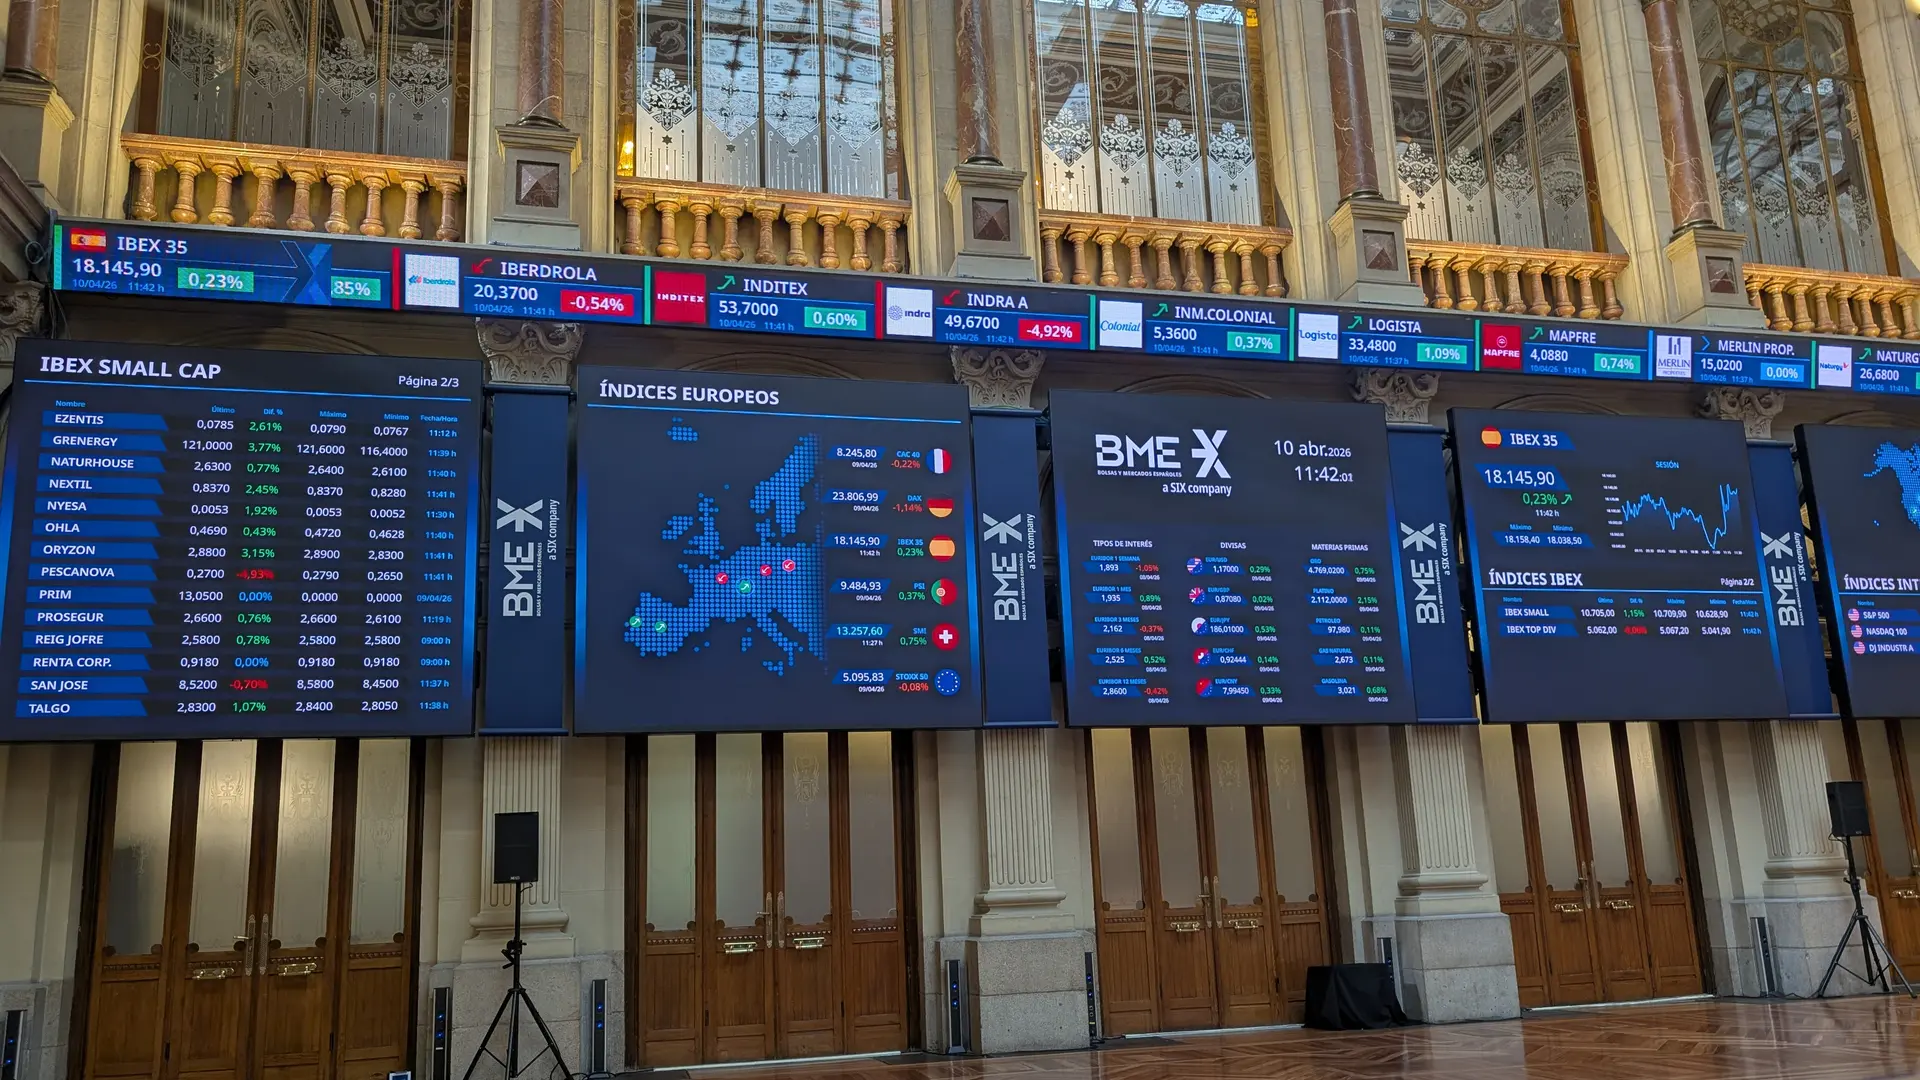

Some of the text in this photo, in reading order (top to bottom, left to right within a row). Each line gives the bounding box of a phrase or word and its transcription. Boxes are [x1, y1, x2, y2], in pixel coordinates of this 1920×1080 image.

[118, 237, 187, 254] IBEX 35
[73, 259, 243, 289] 18.145,90 0,23%
[501, 262, 597, 281] IBERDROLA
[128, 281, 155, 292] 11:42
[158, 283, 165, 293] h
[744, 279, 807, 295] INDITEX
[474, 284, 624, 311] 20,3700 -0,54%
[658, 293, 704, 302] INDITEX
[967, 293, 1028, 309] INDRA A
[719, 300, 857, 326] 53,7000 0,60%
[1174, 305, 1276, 325] INM.COLONIAL
[944, 315, 1072, 338] 49,6700 -4,92%
[1100, 320, 1141, 334] Colonial
[1369, 319, 1421, 333] LOGISTA
[1154, 327, 1197, 340] 5,3600
[1550, 330, 1596, 344] MAPFRE
[1235, 336, 1273, 349] 0,37%
[1349, 338, 1460, 360] 33,4800 1,09%
[1718, 340, 1794, 355] MERLIN PROP.
[1484, 349, 1519, 357] MAPFRE
[1530, 349, 1634, 370] 4,0880 0,74%
[1877, 350, 1920, 364] NATURG
[40, 357, 221, 379] IBEX SMALL CAP
[1658, 358, 1690, 367] MERLIN
[1701, 358, 1798, 378] 15,0200 0,00%
[1860, 368, 1899, 381] 26,6800
[399, 376, 459, 388] Página 2/3
[600, 379, 779, 405] ÍNDICES EUROPEOS
[55, 399, 347, 418] Nombre Máximo
[55, 414, 282, 431] EZENTIS 0,0785 2,61%
[53, 436, 232, 451] GRENERGY 121,0000
[1510, 433, 1558, 446] IBEX 35
[837, 448, 877, 458] 8.245,80
[1095, 434, 1181, 469] BME
[1274, 440, 1293, 455] 10
[51, 457, 231, 472] NATURHOUSE 2,6300
[1656, 460, 1679, 469] SESIÓN
[1153, 470, 1182, 478] ESPAÑOLES
[1485, 469, 1554, 486] 18.145,90
[49, 479, 230, 493] NEXTIL 0,8370
[1162, 482, 1232, 497] a SIX company
[833, 492, 878, 502] 23.806,99
[1523, 493, 1557, 506] 0,23%
[47, 501, 228, 514] NYESA 0,0053
[549, 499, 560, 538] company
[45, 523, 227, 536] OHLA 0,4690
[1026, 513, 1036, 549] company
[835, 536, 880, 546] 18.145,90
[1439, 522, 1448, 557] company
[1505, 535, 1582, 545] 18.158,40 18.038,50
[43, 545, 95, 554] ORYZON
[547, 540, 556, 554] SIX
[1794, 532, 1804, 563] company
[1027, 550, 1035, 563] SIX
[1441, 557, 1450, 569] SIX
[41, 567, 114, 577] PESCANOVA
[1099, 564, 1119, 572] 1,893
[503, 542, 534, 616] BME
[1489, 568, 1583, 586] ÍNDICES IBEX
[1721, 578, 1754, 587] Página 2/2
[1844, 574, 1895, 590] ÍNDICES
[841, 581, 881, 591] 9.484,93
[991, 552, 1020, 621] BME
[1410, 560, 1439, 624] BME
[40, 590, 71, 599] PRIM
[1771, 566, 1799, 626] BME
[38, 613, 103, 622] PROSEGUR
[1505, 608, 1549, 617] IBEX SMALL
[1863, 611, 1876, 619] S&P
[837, 627, 883, 636] 13.257,60
[1103, 625, 1123, 633] 2,162
[1328, 626, 1350, 634] 97,980
[1507, 626, 1556, 634] IBEX TOP DIV
[1866, 628, 1908, 636] NASDAQ 100
[36, 635, 103, 646] REIG JOFRE
[1869, 644, 1914, 653] DJ INDUSTR A
[33, 657, 112, 668] RENTA CORP.
[843, 673, 884, 682] 5.095,83
[895, 673, 918, 681] STOXX
[30, 680, 88, 692] SAN JOSE
[29, 703, 216, 713] TALGO 2,8300
